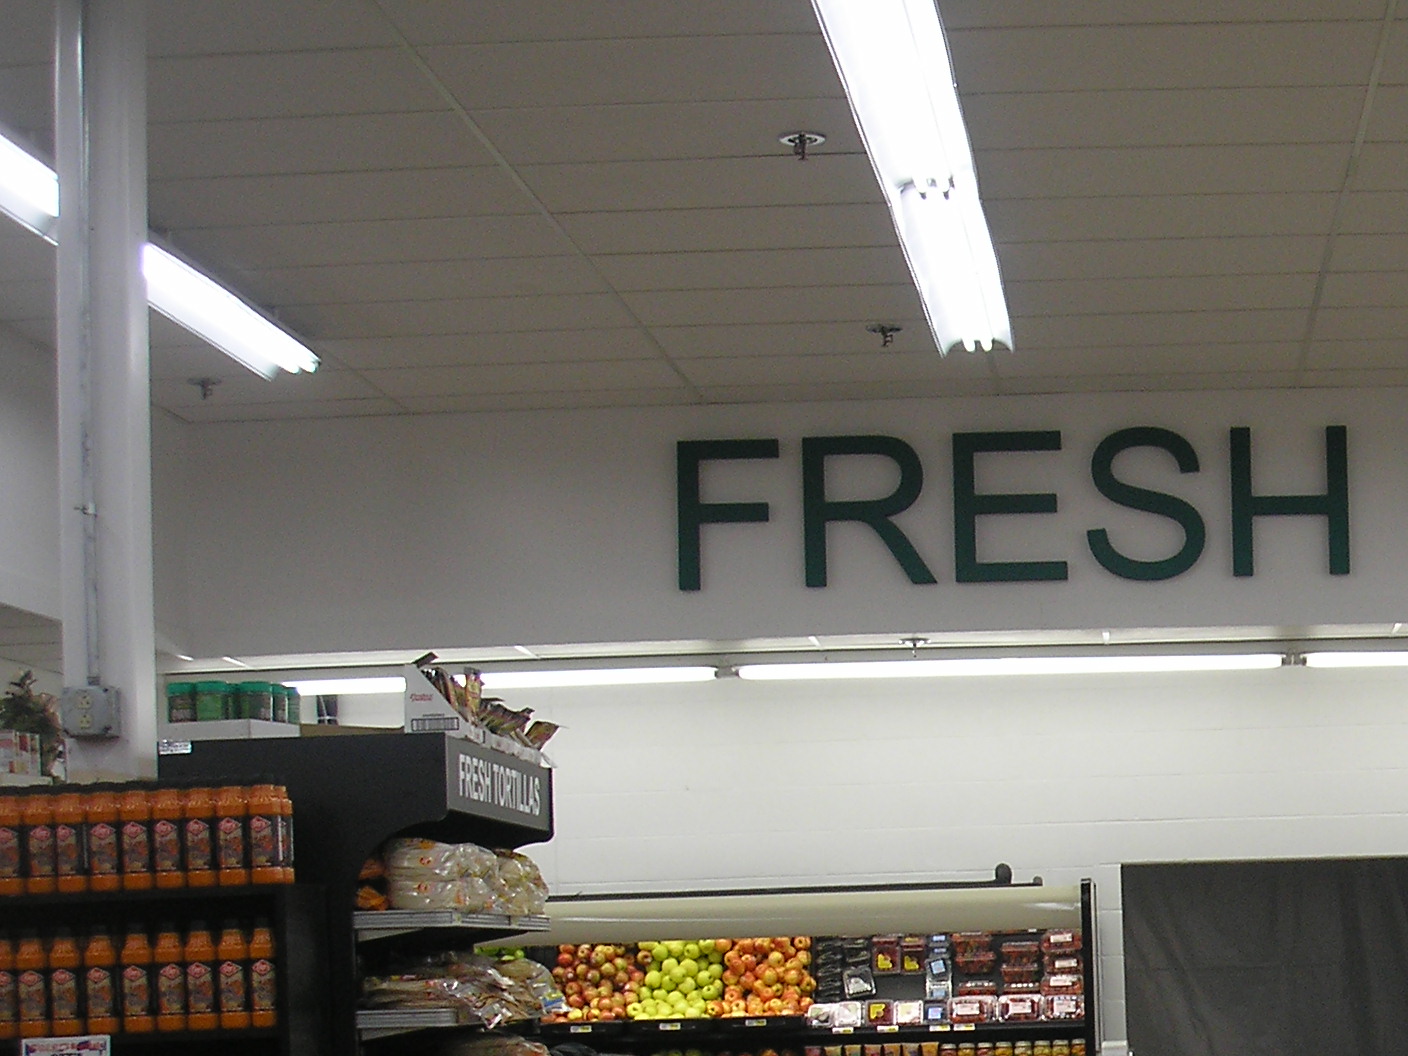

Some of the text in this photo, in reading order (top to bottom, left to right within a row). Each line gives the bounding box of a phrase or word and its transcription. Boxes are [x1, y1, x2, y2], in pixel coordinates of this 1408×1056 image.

[676, 425, 1350, 591] FRESH
[459, 753, 540, 816] FRESH TORTILLAS
